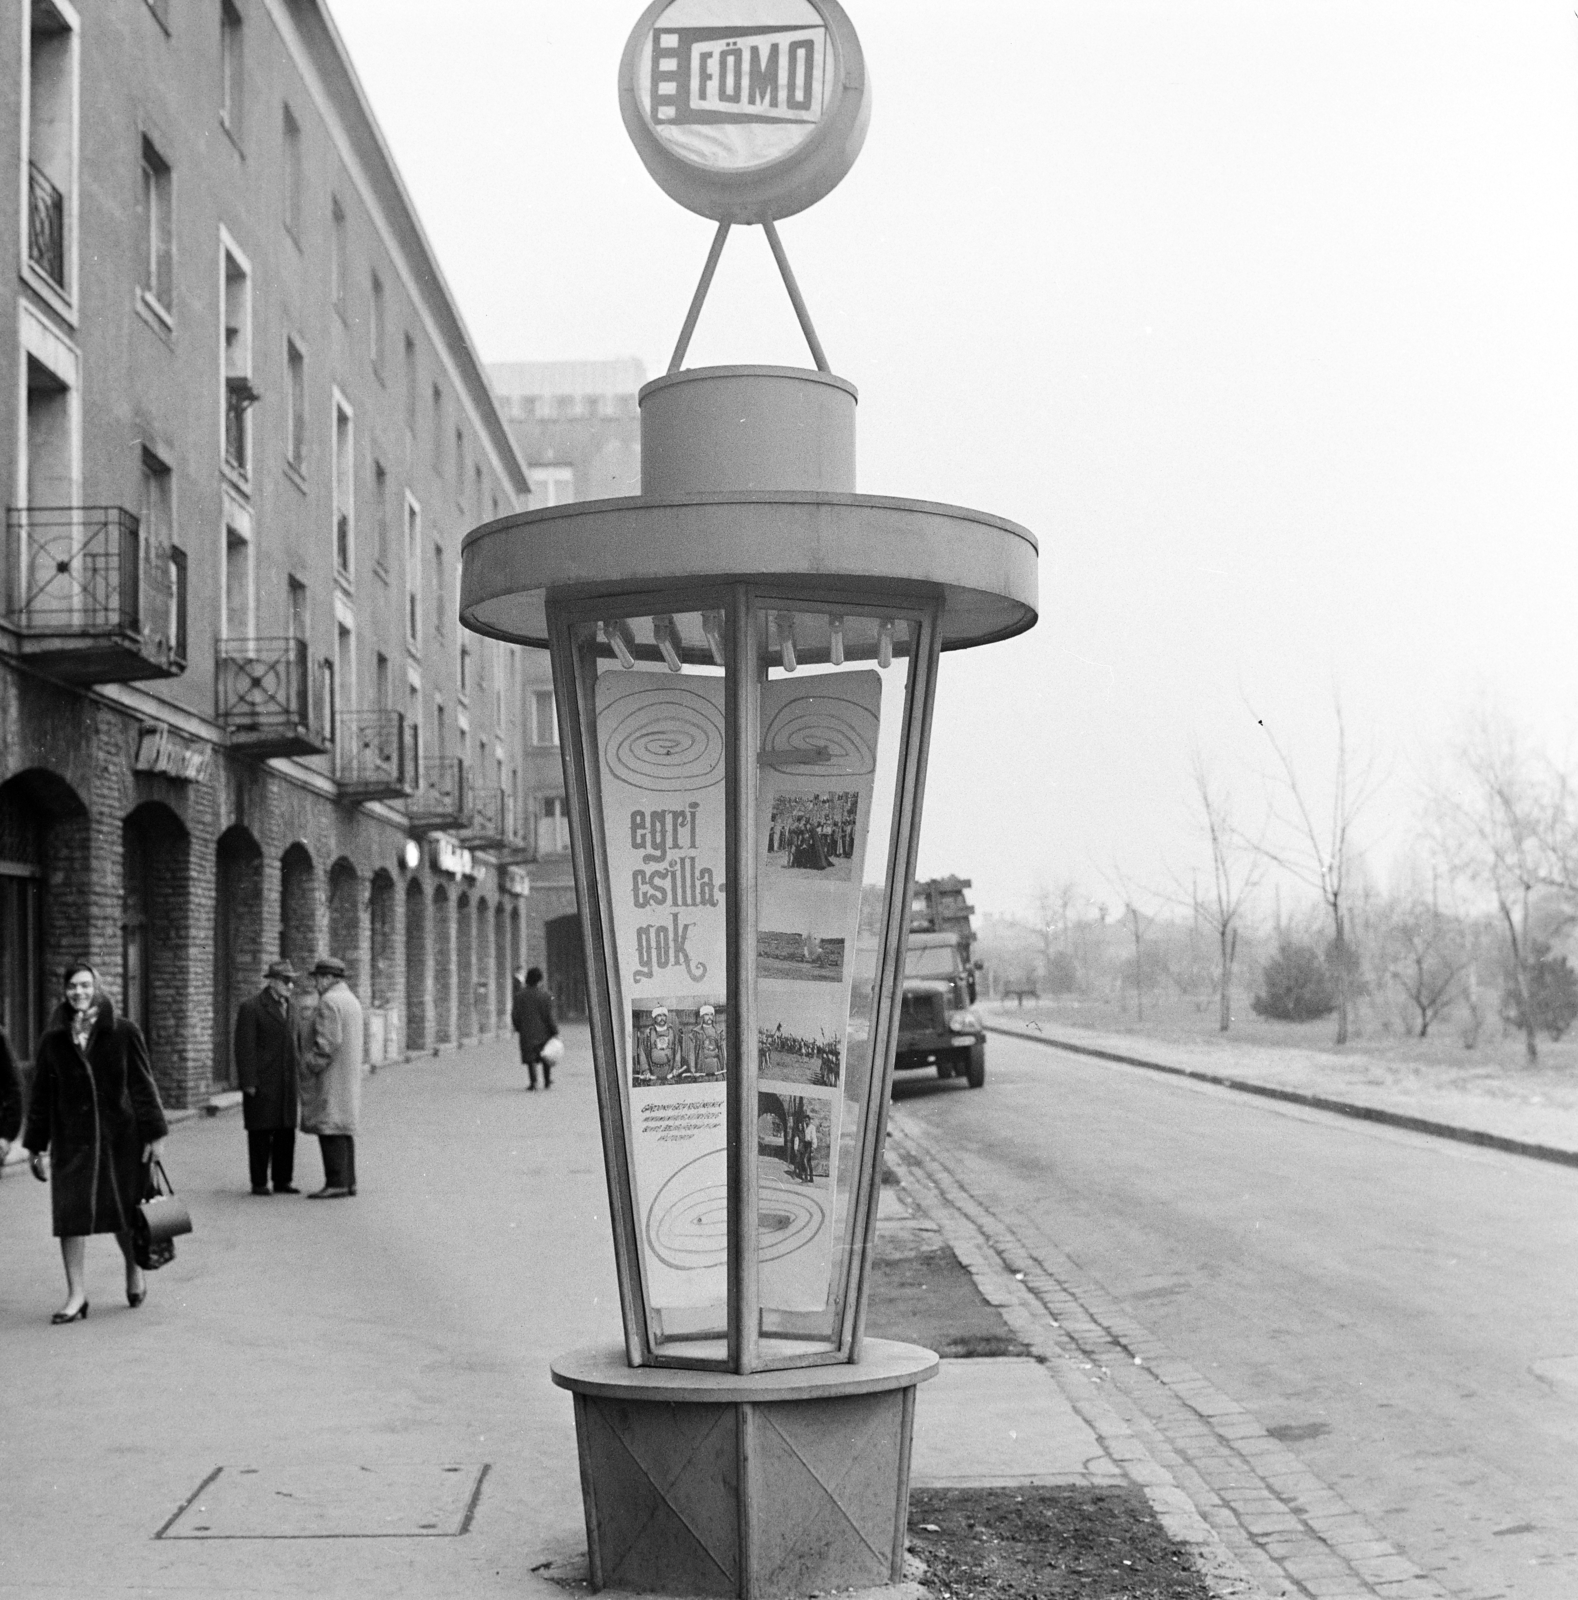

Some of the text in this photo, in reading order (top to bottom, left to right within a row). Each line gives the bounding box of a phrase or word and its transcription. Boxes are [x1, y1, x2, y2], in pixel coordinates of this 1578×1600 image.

[698, 39, 815, 112] FÖMO
[629, 801, 700, 865] egri
[632, 912, 708, 984] gok
